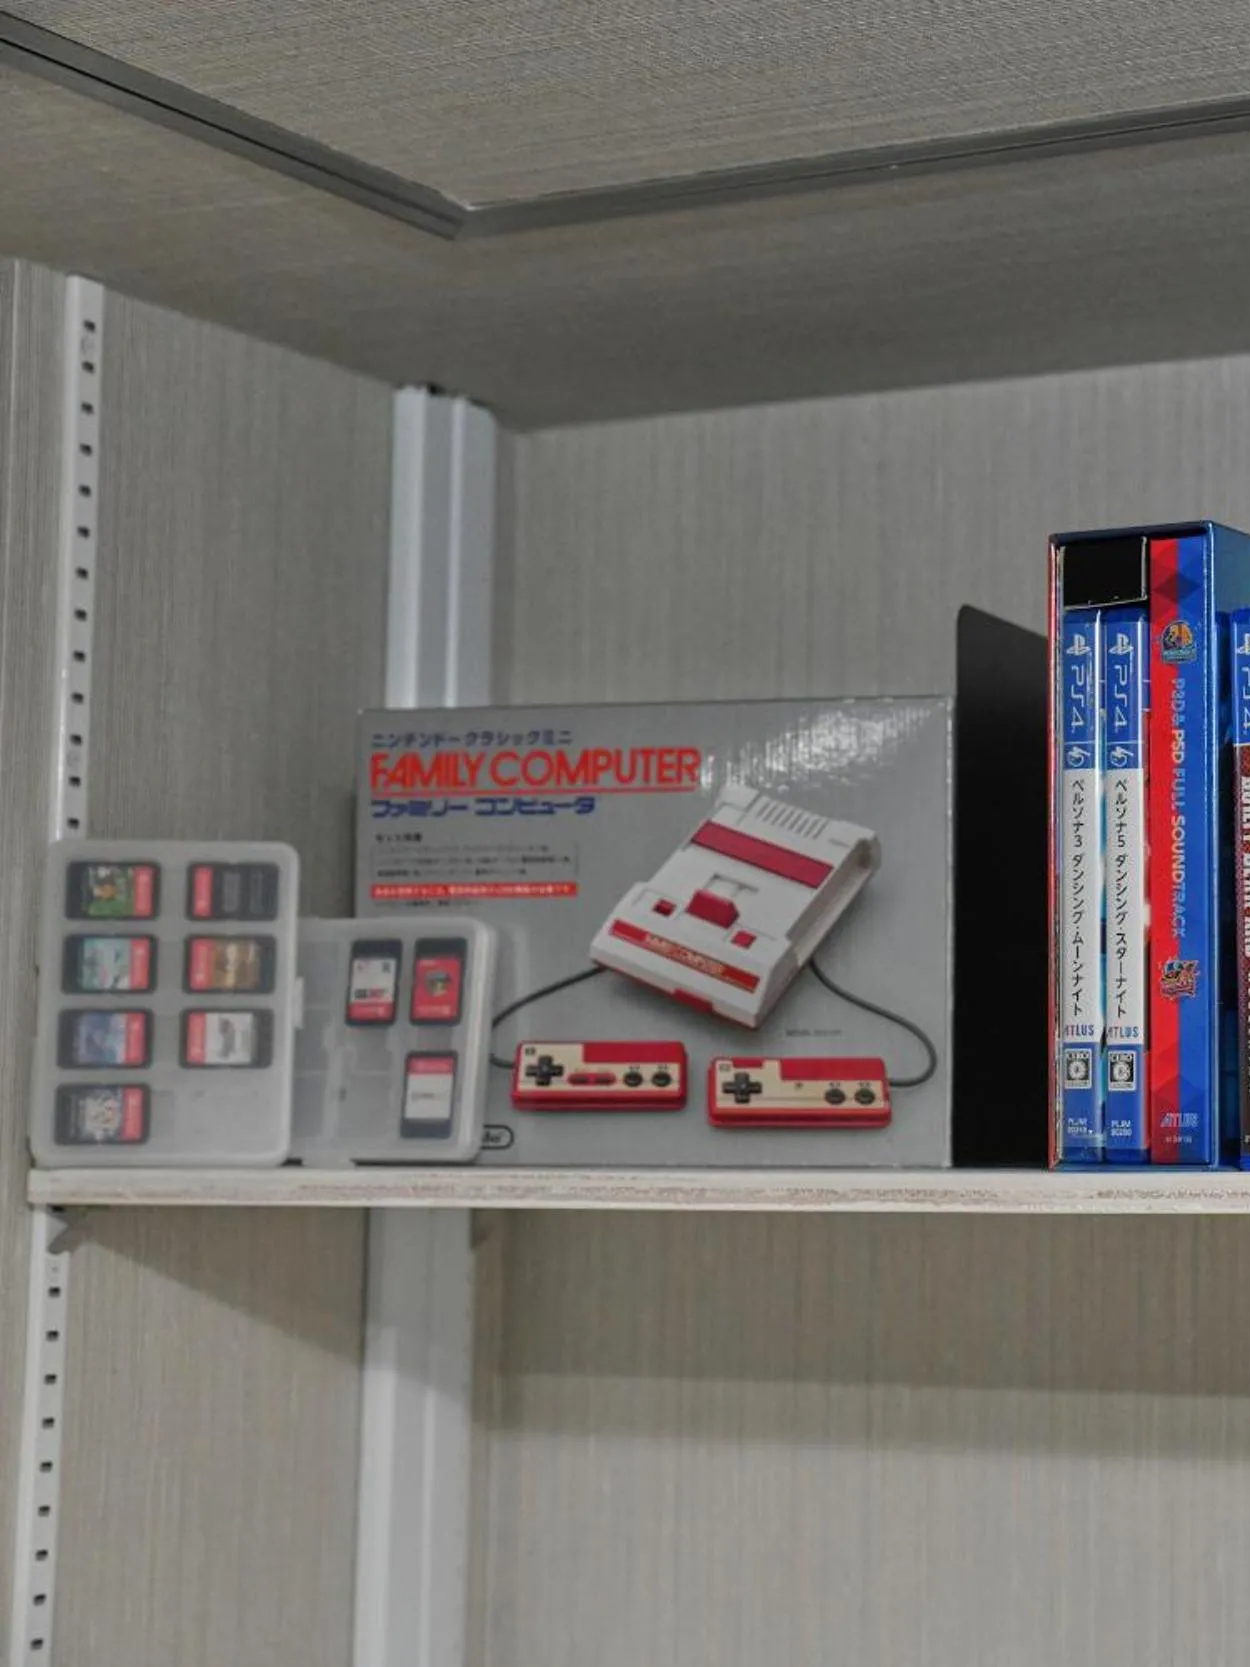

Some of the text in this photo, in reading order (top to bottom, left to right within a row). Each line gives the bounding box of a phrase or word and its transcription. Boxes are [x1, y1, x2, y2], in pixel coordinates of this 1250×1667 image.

[1070, 664, 1086, 733] PS4
[1114, 664, 1129, 733] PS4
[370, 746, 699, 789] FAMILY COMPUTER
[1171, 769, 1185, 810] FULL
[371, 796, 596, 818] ファミリー コンピュータ
[1171, 815, 1186, 938] SOUNDTRACK
